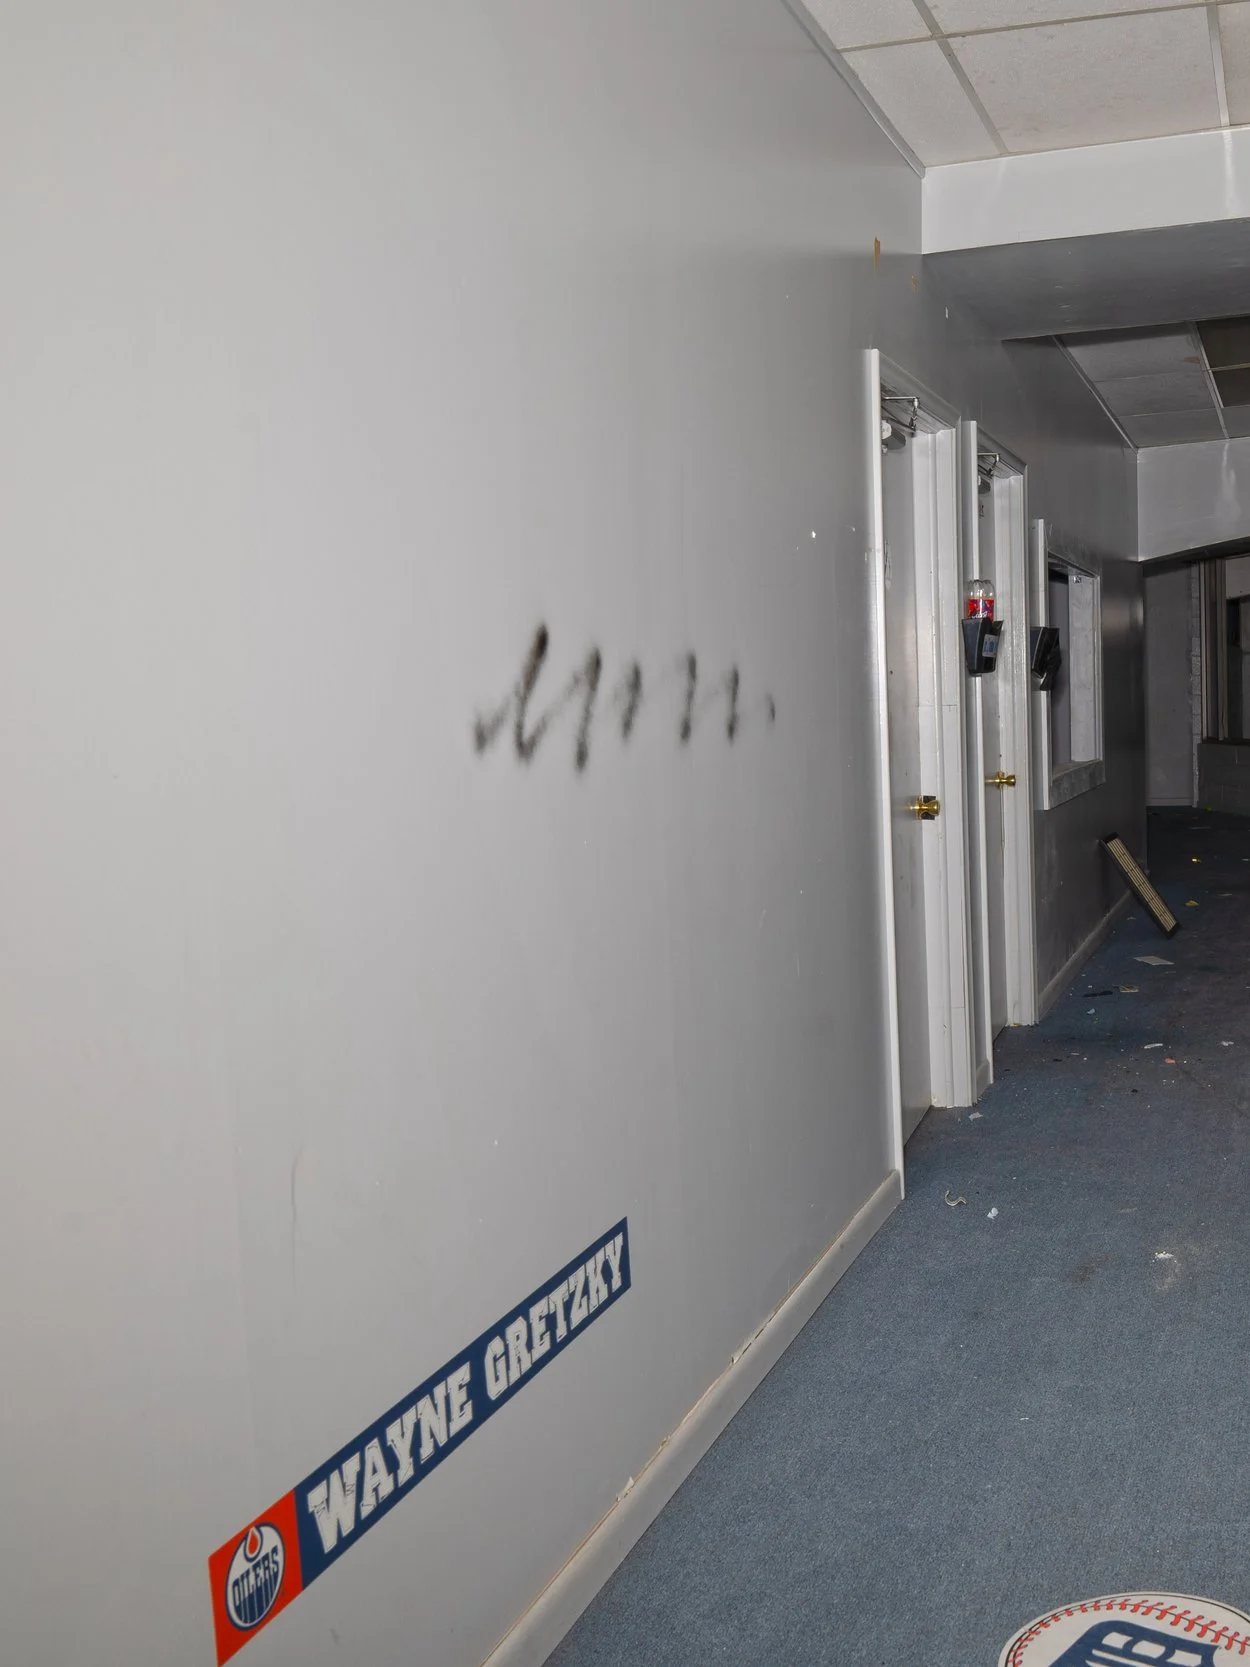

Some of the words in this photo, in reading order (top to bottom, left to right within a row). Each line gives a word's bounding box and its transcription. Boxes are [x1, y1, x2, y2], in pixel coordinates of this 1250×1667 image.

[307, 1361, 474, 1554] WAYNE
[484, 1232, 625, 1400] GRETZKY
[232, 1544, 280, 1624] OILERS
